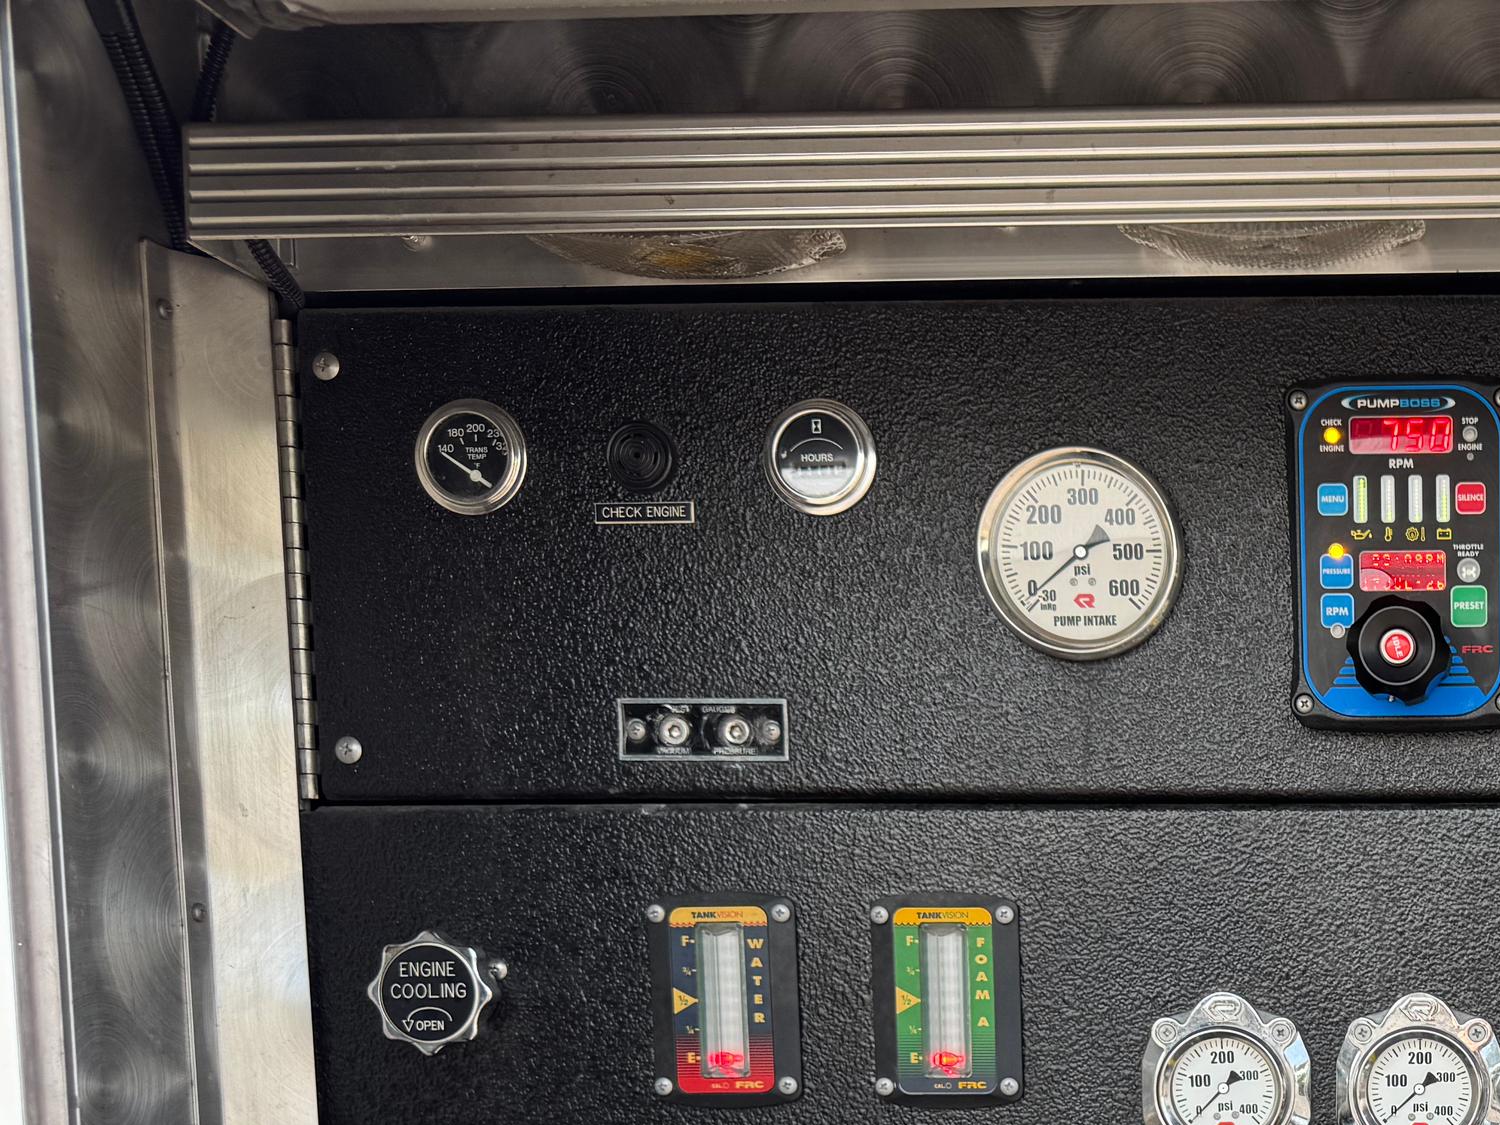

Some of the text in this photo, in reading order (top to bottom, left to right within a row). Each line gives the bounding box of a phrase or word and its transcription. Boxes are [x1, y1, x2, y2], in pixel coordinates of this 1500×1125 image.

[1357, 399, 1441, 409] PUMPBOSS
[1384, 419, 1449, 451] 750
[465, 446, 488, 454] TRANS
[1458, 443, 1483, 451] ENGINE
[801, 453, 833, 463] HOURS
[1389, 459, 1414, 469] RPM
[1067, 488, 1098, 505] 300
[602, 505, 686, 518] CHECK ENGINE
[1026, 504, 1061, 525] 200
[1105, 508, 1135, 525] 400
[1020, 541, 1053, 560] 100
[1113, 543, 1143, 560] 500
[1109, 580, 1139, 597] 600
[1326, 607, 1348, 616] RPM
[1054, 615, 1117, 626] PUMP INTAKE
[400, 962, 455, 977] ENGINE
[975, 937, 990, 999] FOAM
[747, 939, 765, 1023] WATER
[391, 983, 466, 999] COOLING
[416, 1020, 444, 1031] OPEN
[1211, 1052, 1234, 1064] 200
[1408, 1052, 1432, 1065] 200
